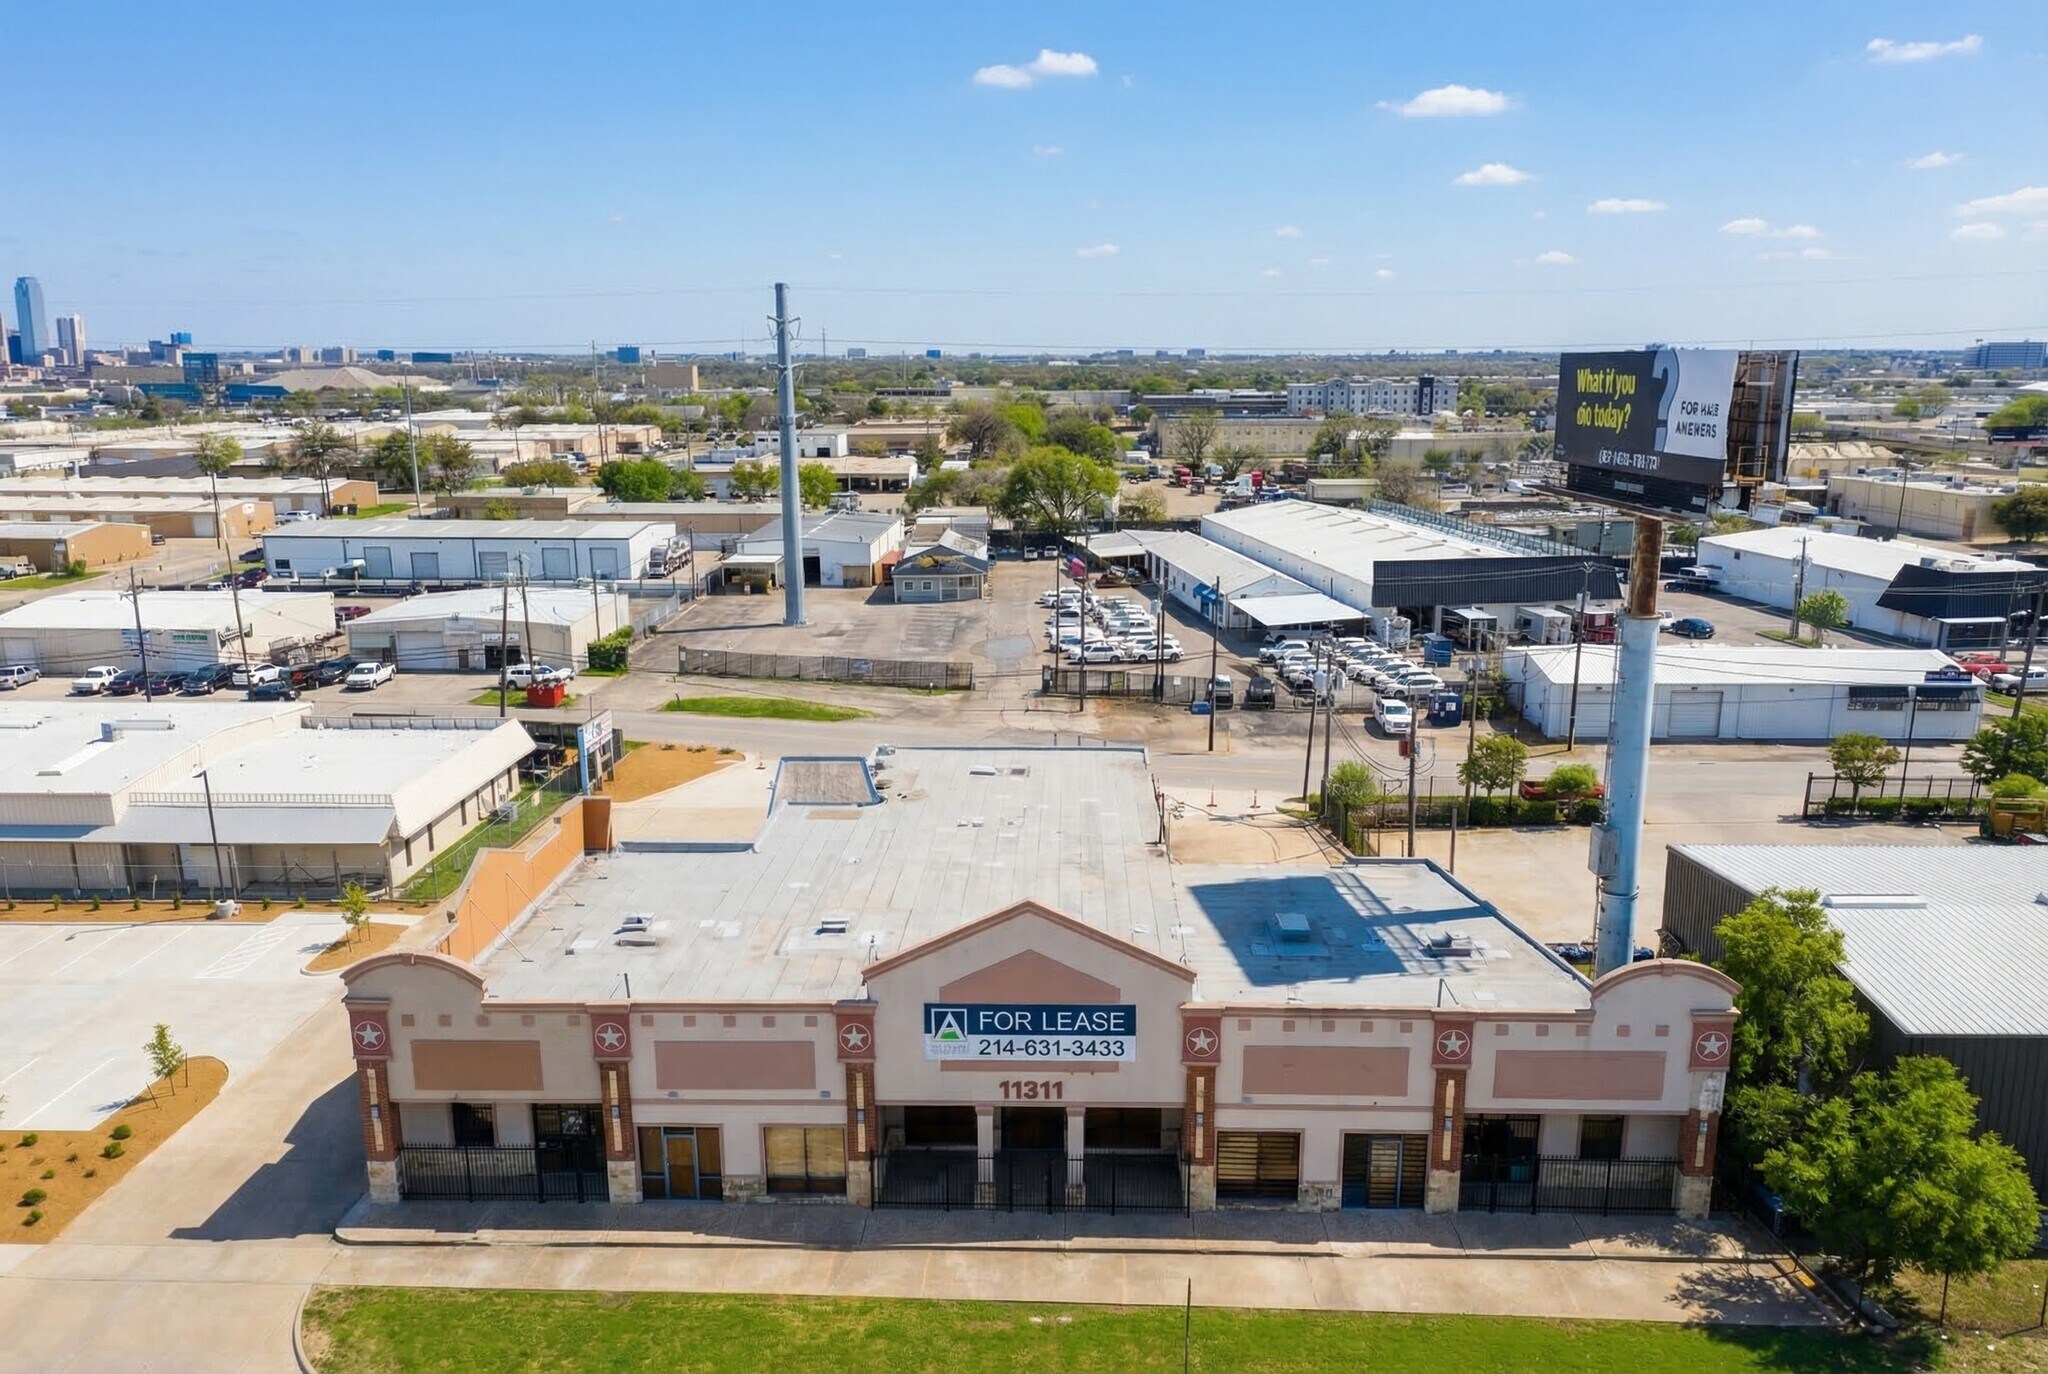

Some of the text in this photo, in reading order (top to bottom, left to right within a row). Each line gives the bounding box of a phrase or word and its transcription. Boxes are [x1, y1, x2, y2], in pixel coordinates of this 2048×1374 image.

[1577, 367, 1636, 400] What if you
[1594, 402, 1631, 434] today?
[979, 1011, 1126, 1032] FOR LEASE
[978, 1038, 1126, 1057] 214-631-3433
[999, 1080, 1064, 1100] 11311
